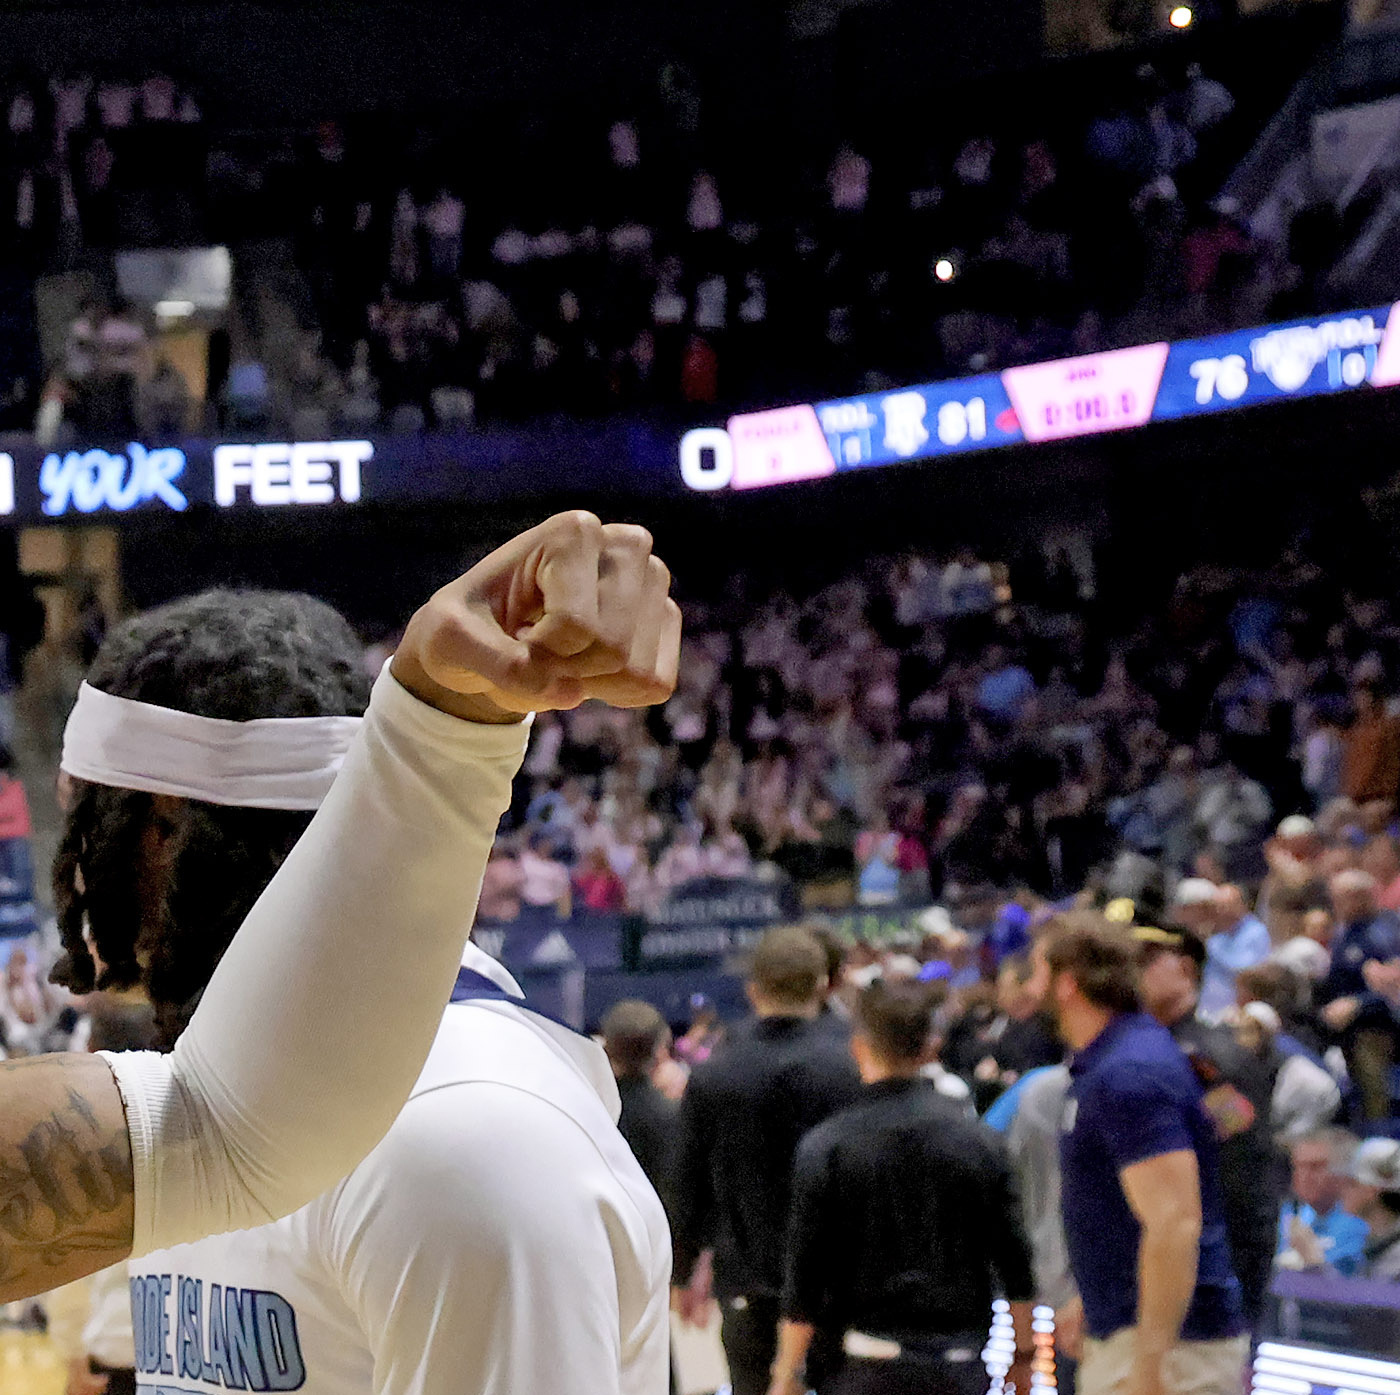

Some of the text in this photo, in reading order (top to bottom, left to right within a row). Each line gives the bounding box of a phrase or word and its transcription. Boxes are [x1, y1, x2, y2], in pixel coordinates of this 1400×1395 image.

[1190, 354, 1249, 404] 76
[937, 397, 986, 446] 81
[39, 442, 188, 516] YOUR
[213, 440, 375, 507] FEET
[176, 1274, 307, 1393] ISLAND
